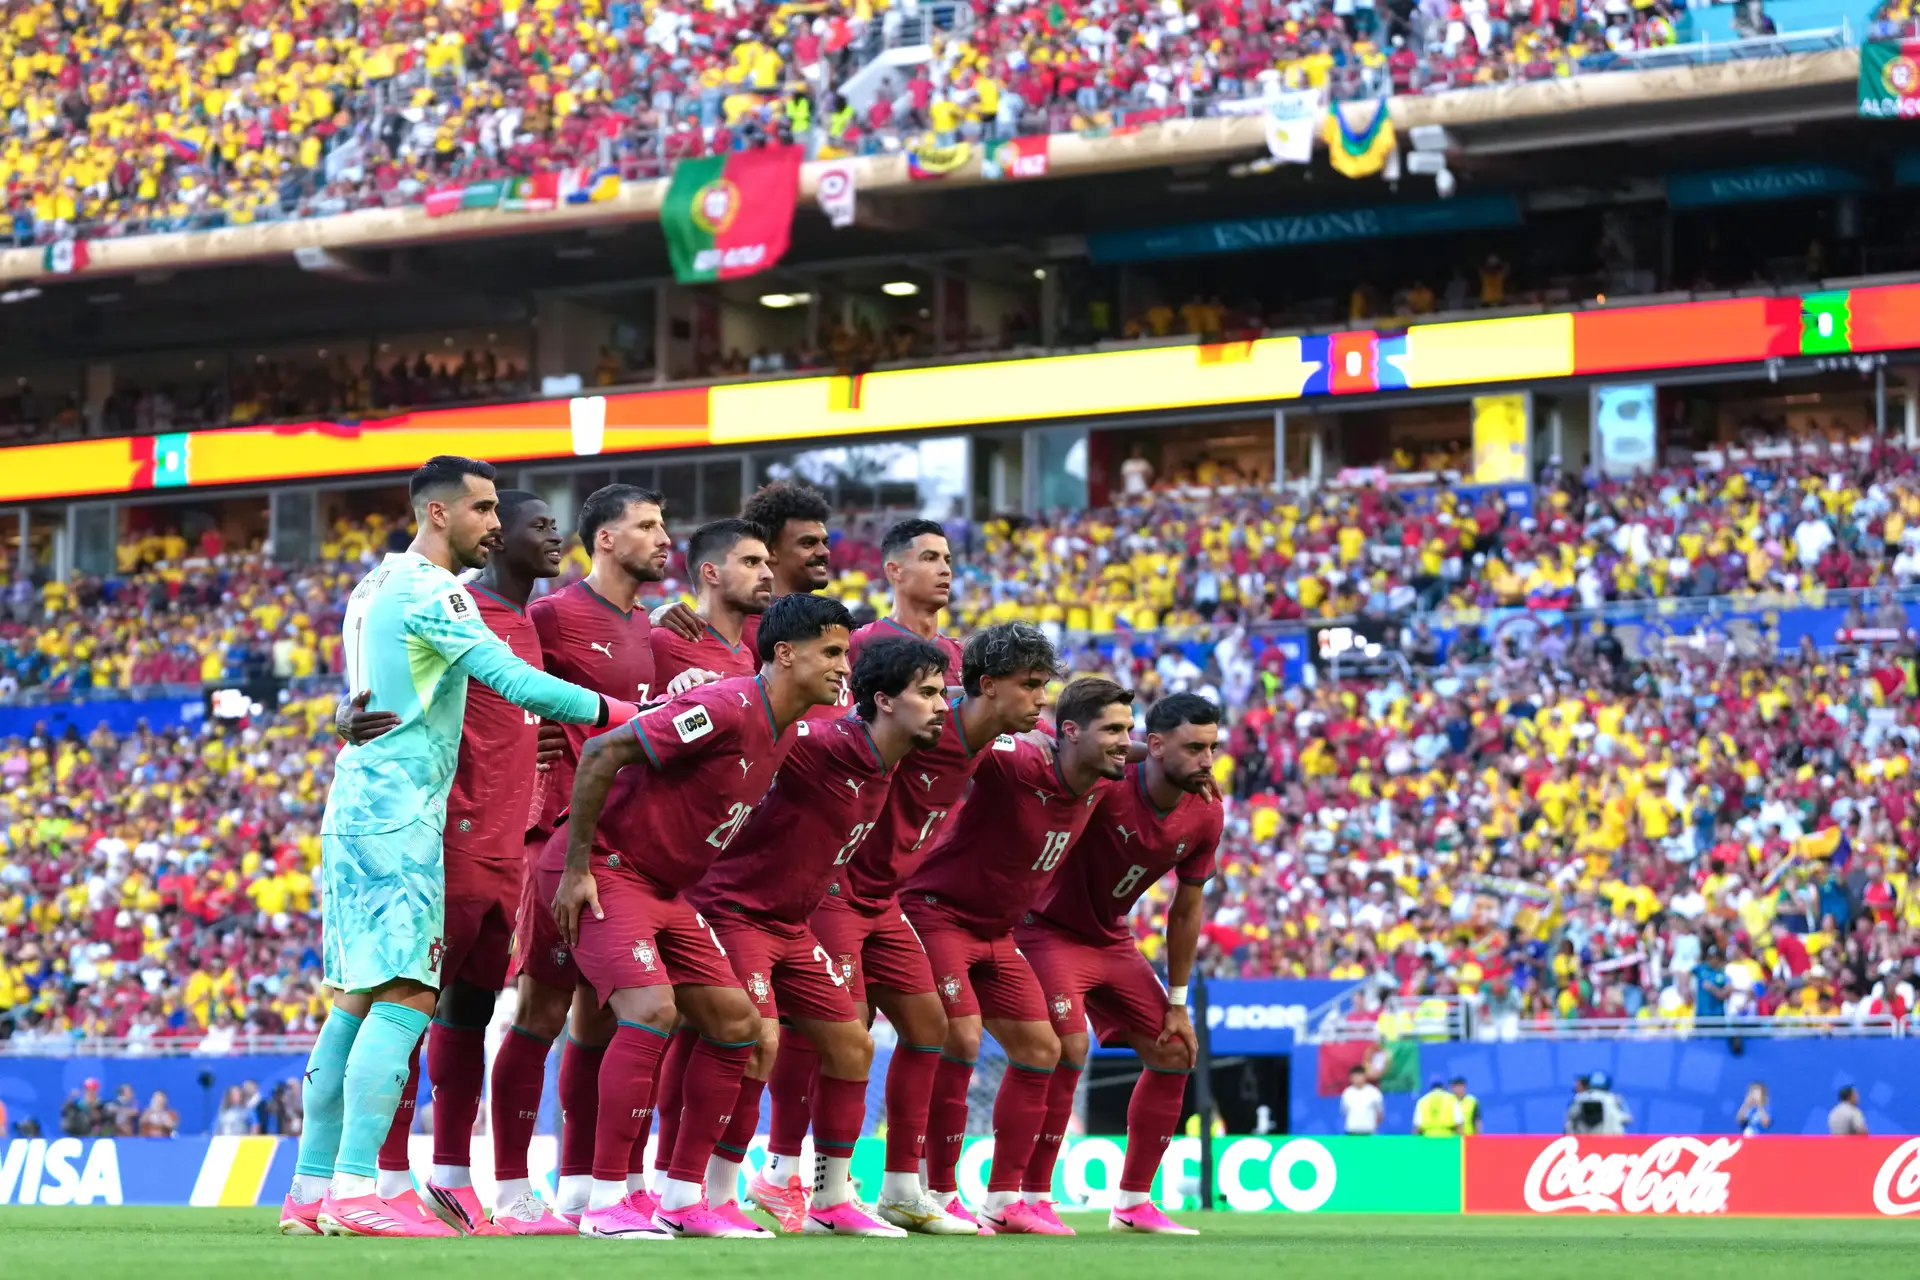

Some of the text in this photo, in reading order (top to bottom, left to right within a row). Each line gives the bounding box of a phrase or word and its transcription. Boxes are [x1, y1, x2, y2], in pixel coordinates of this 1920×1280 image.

[1212, 208, 1381, 249] ENDZONE
[705, 801, 753, 851] 20
[1031, 830, 1072, 872] 18
[1112, 864, 1149, 898] 8
[812, 944, 846, 987] 2
[1523, 1135, 1743, 1214] Coca-Cola
